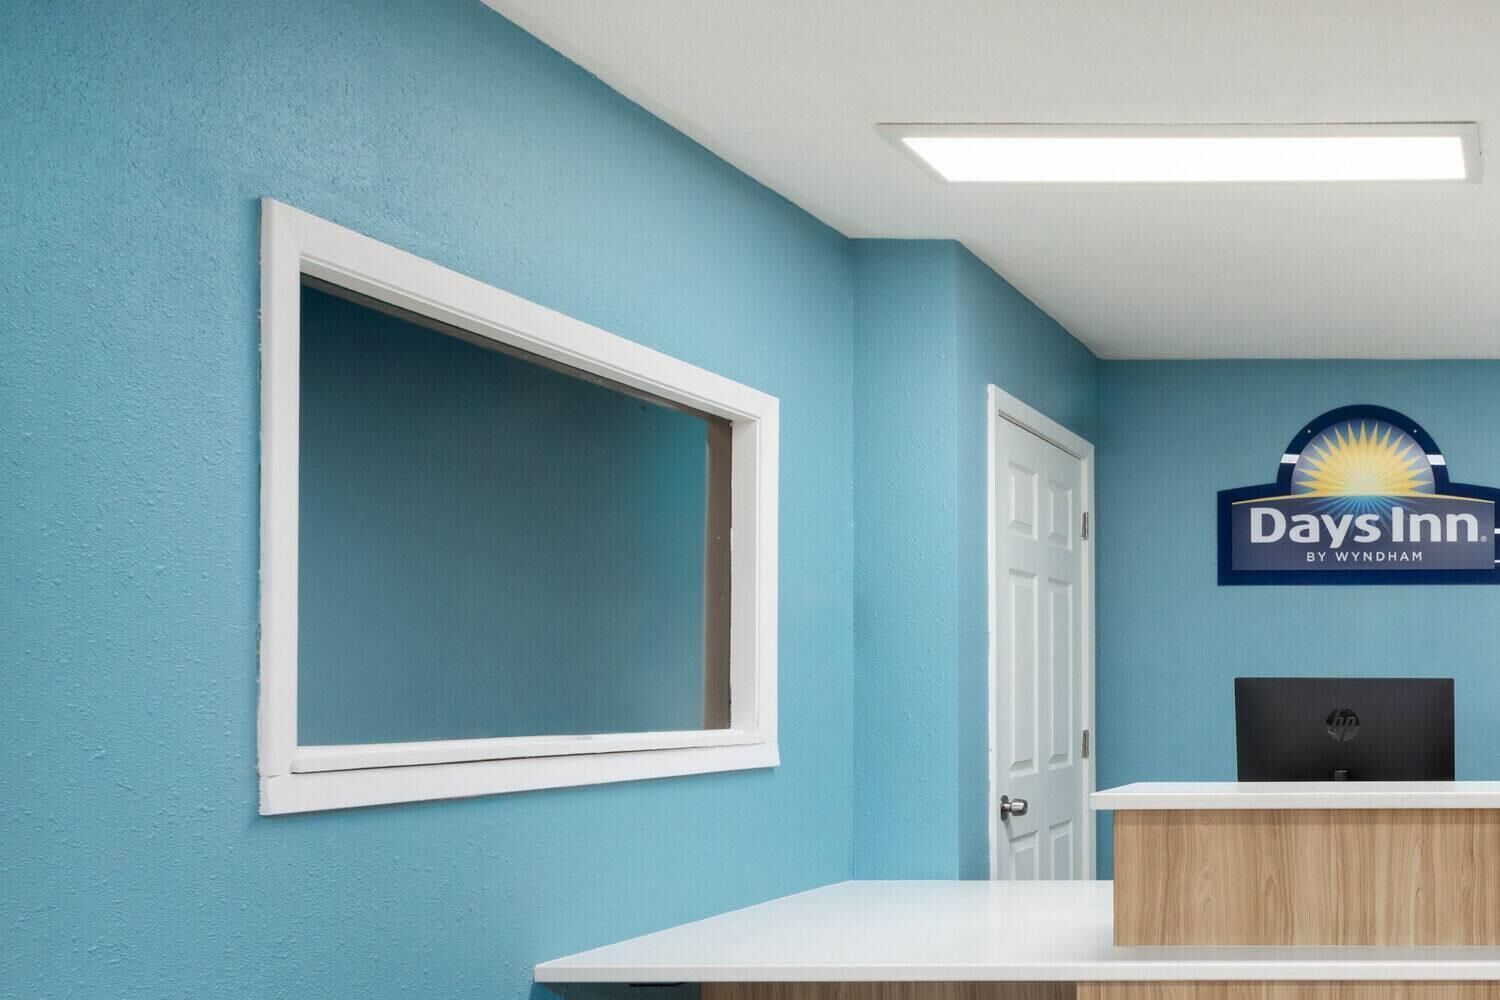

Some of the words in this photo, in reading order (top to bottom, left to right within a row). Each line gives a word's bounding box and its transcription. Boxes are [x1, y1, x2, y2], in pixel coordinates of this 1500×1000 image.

[1250, 508, 1381, 549] Days
[1306, 551, 1327, 562] BY
[1335, 551, 1423, 562] WYNDHAM
